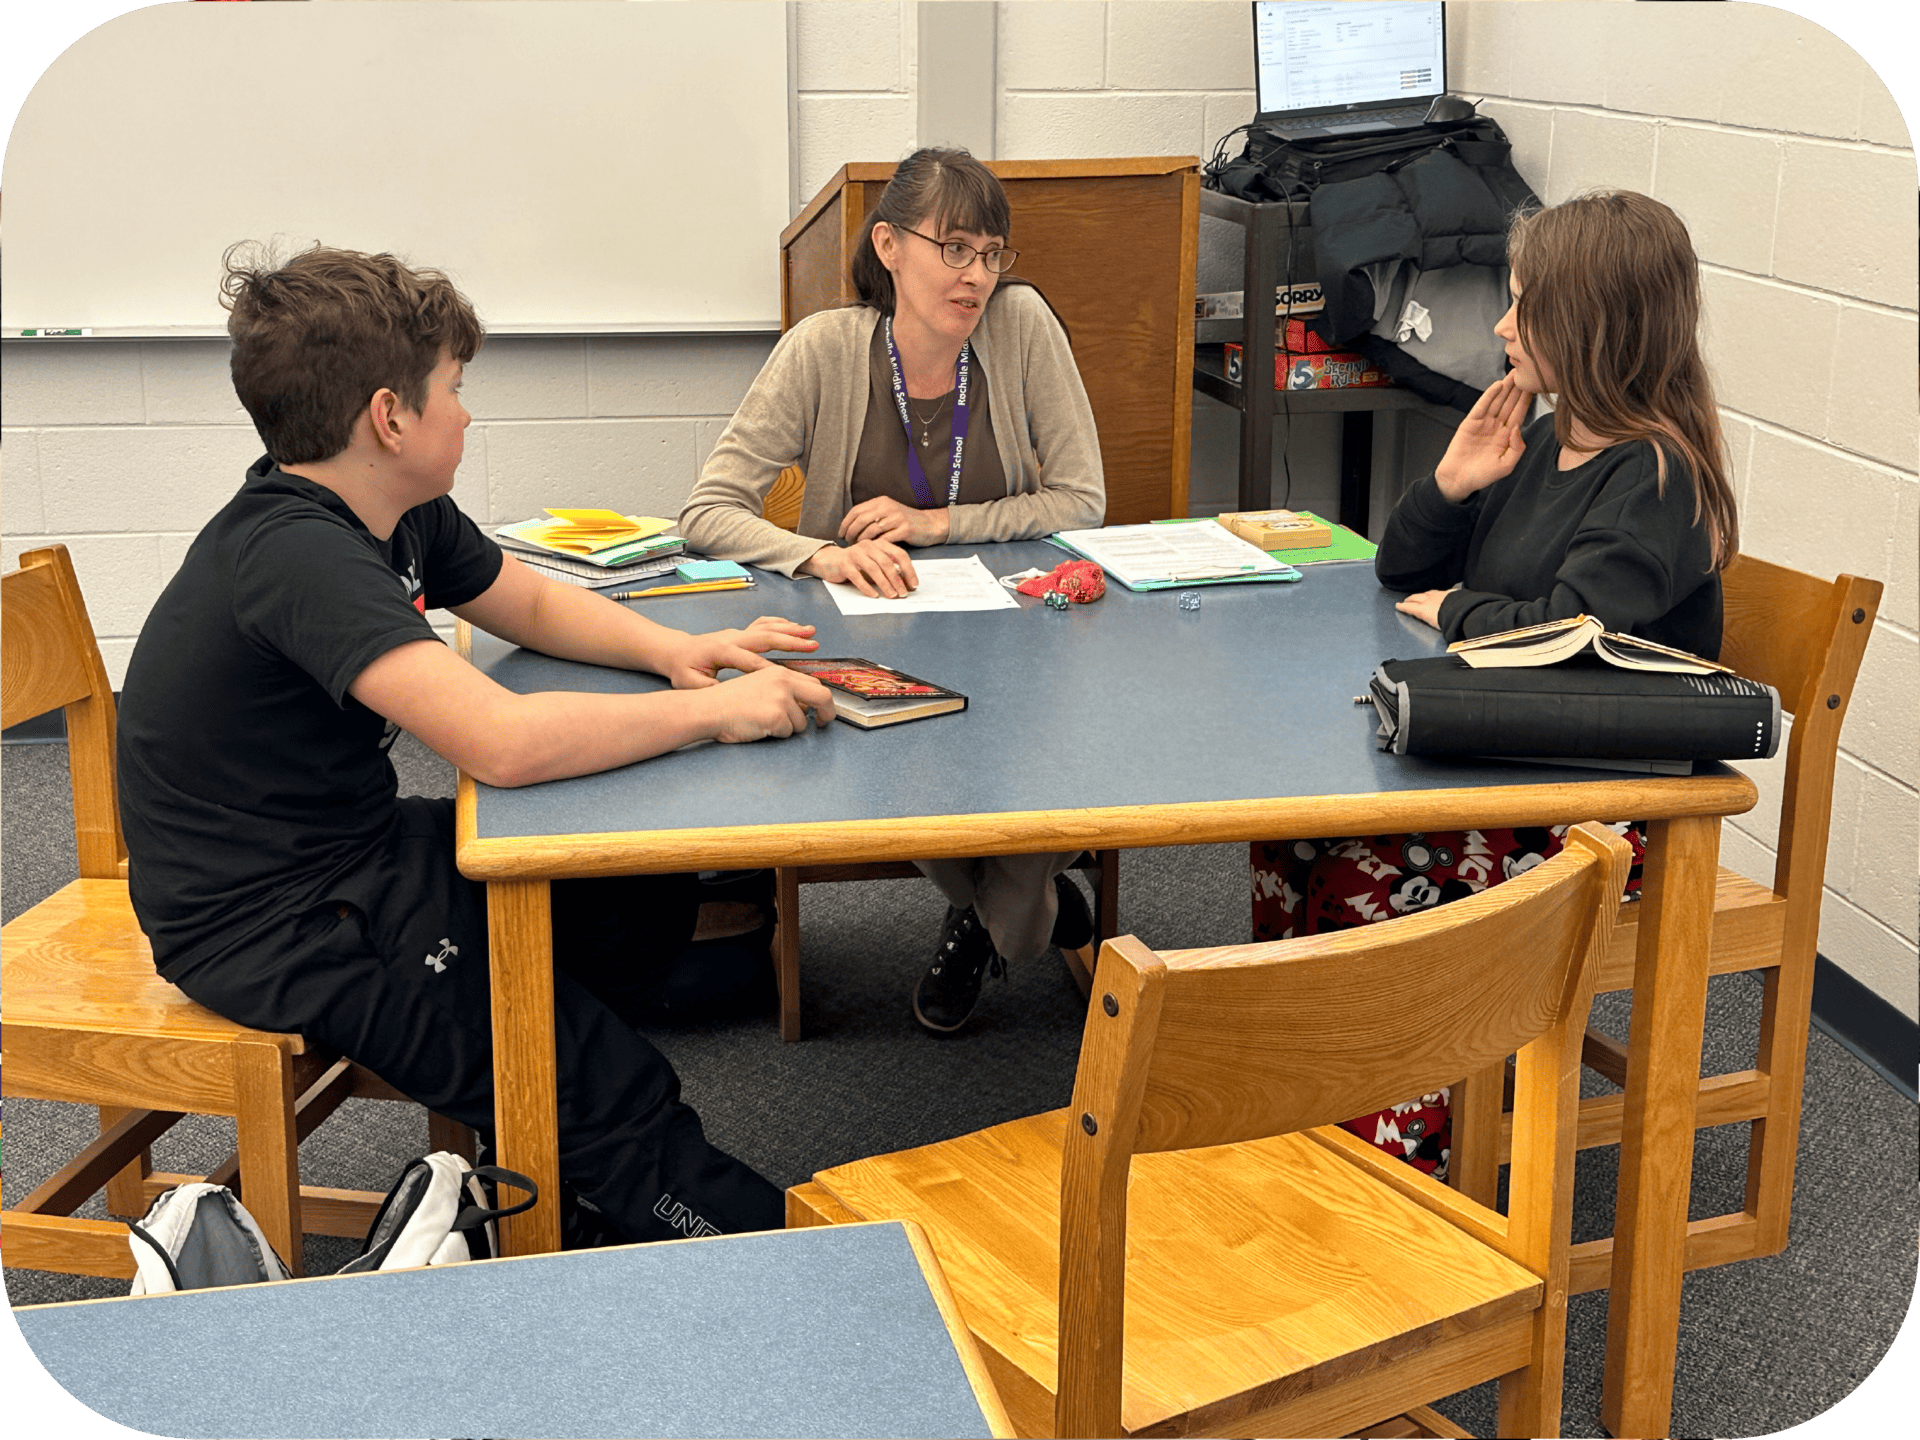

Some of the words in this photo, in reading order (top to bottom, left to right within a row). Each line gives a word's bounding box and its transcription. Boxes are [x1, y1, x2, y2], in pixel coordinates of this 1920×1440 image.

[1229, 349, 1239, 380] 5
[1293, 360, 1312, 390] 5
[957, 365, 969, 406] Rochelle
[896, 391, 910, 424] School
[952, 436, 964, 469] School
[948, 470, 961, 500] Middle
